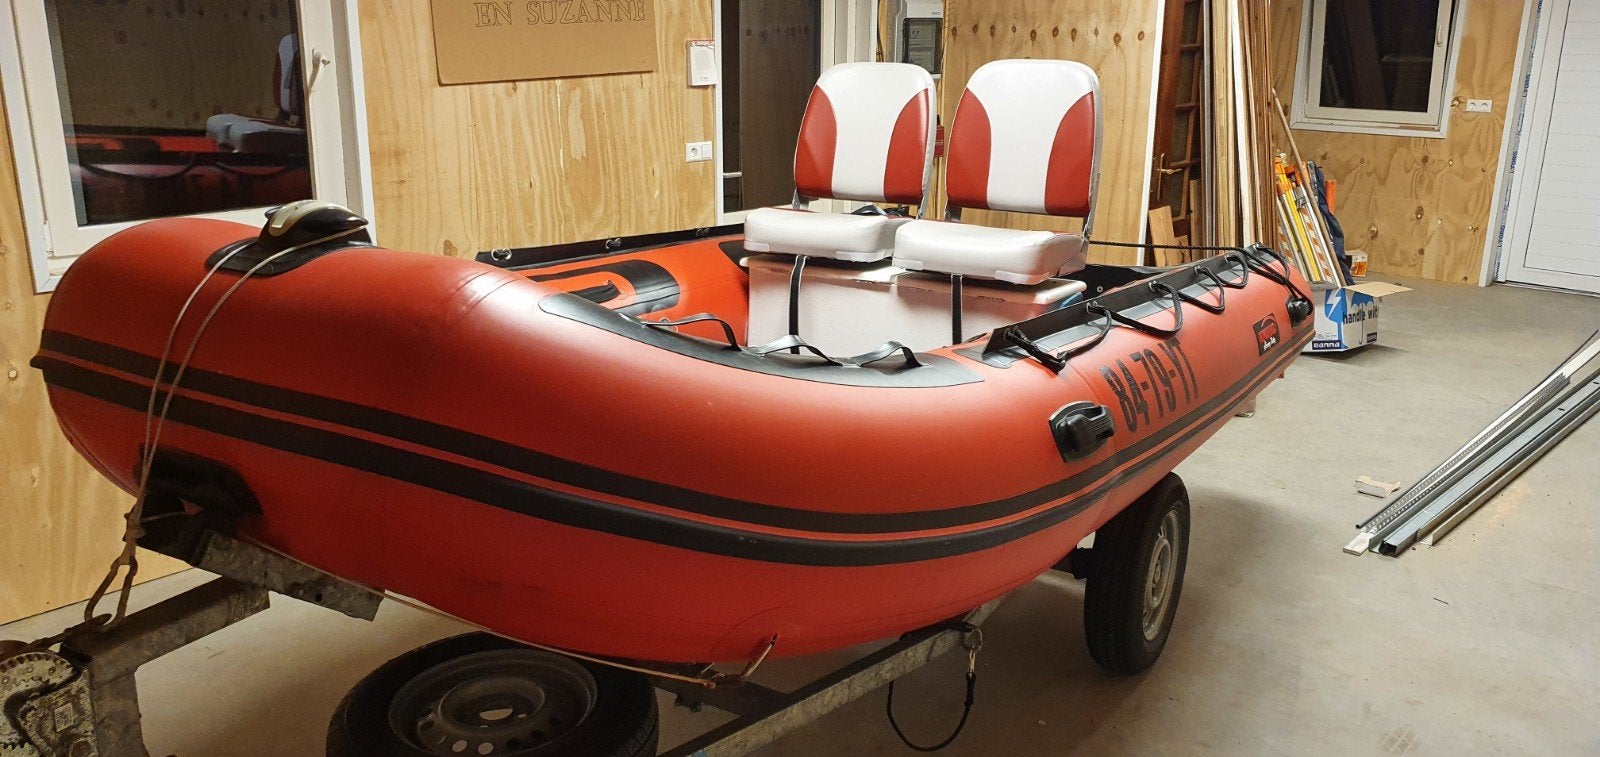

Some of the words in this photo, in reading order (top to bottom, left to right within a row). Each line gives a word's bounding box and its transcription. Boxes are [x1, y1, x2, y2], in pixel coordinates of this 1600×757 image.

[475, 2, 512, 27] EN
[526, 0, 646, 25] SUZANNE
[1342, 308, 1366, 325] handle
